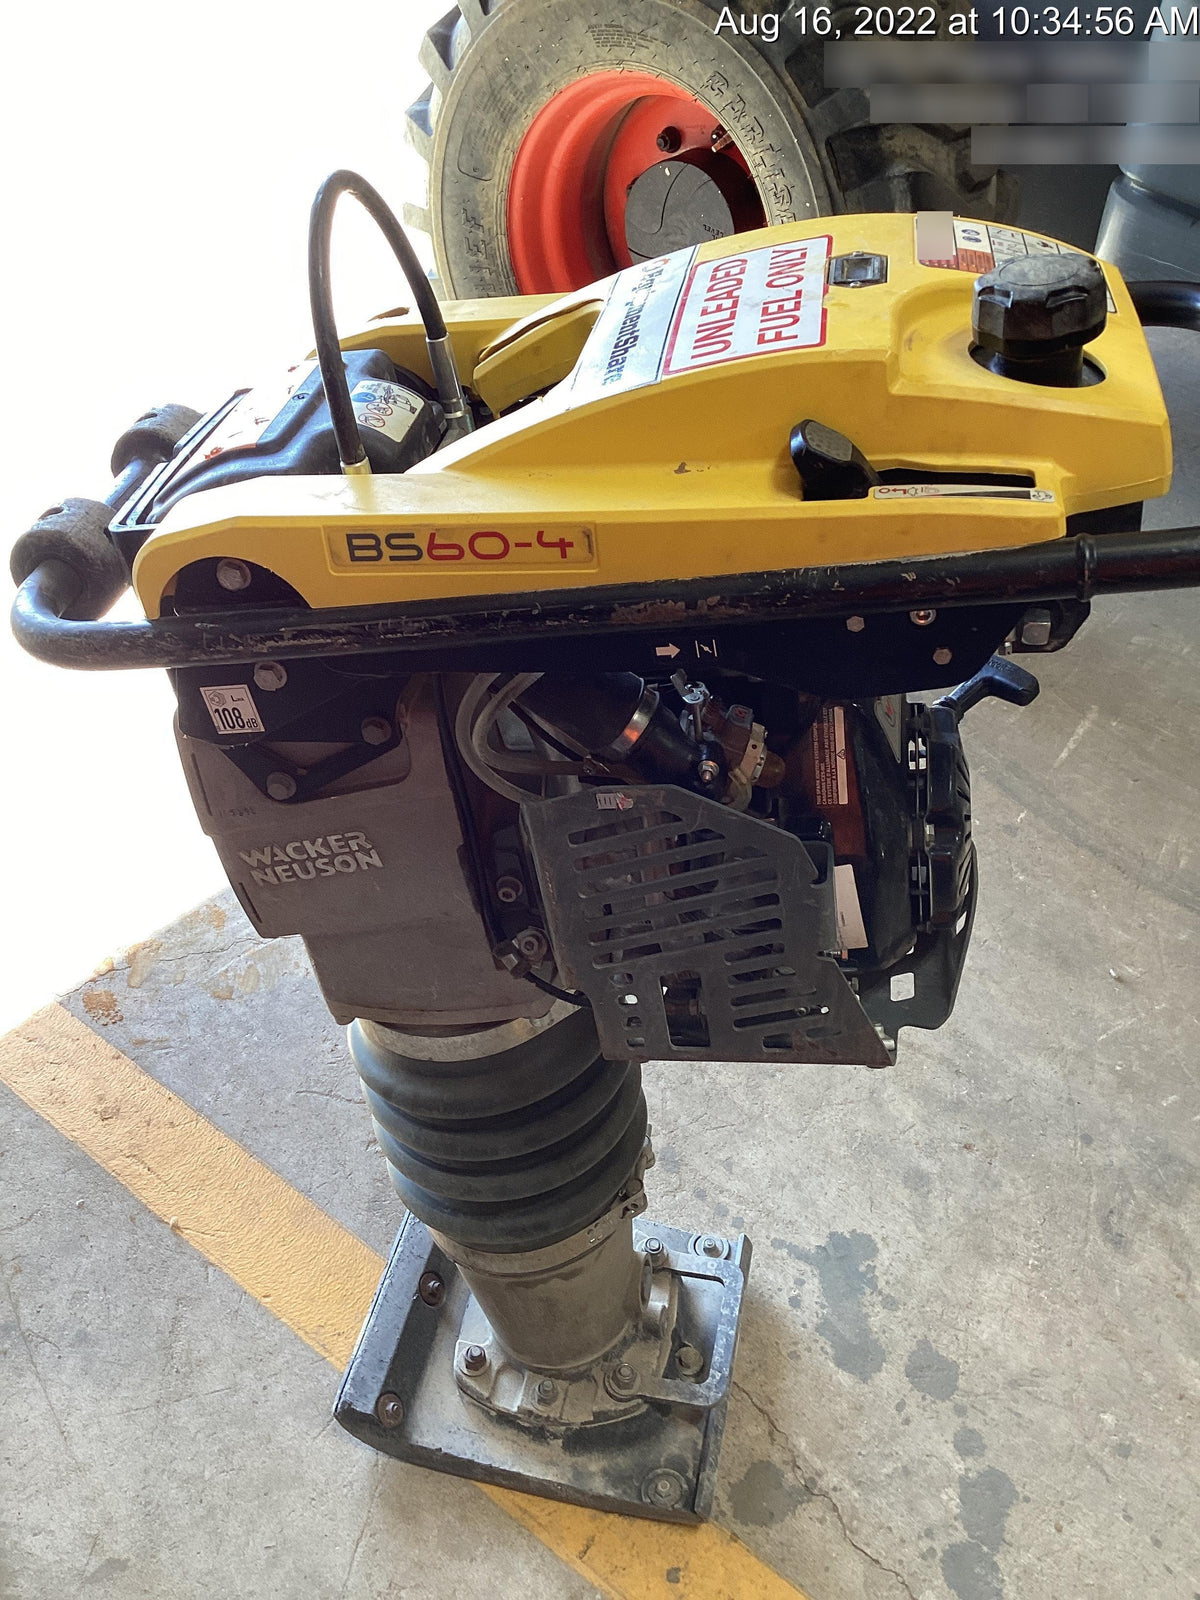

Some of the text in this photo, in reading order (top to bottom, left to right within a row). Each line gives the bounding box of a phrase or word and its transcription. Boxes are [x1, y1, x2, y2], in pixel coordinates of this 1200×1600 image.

[690, 258, 748, 360] UNLEADED
[757, 247, 808, 345] FUEL ONLY
[345, 530, 574, 562] BS60-4
[214, 707, 259, 730] 108 dB
[238, 831, 373, 868] WACKER
[250, 849, 384, 886] NEUSON
